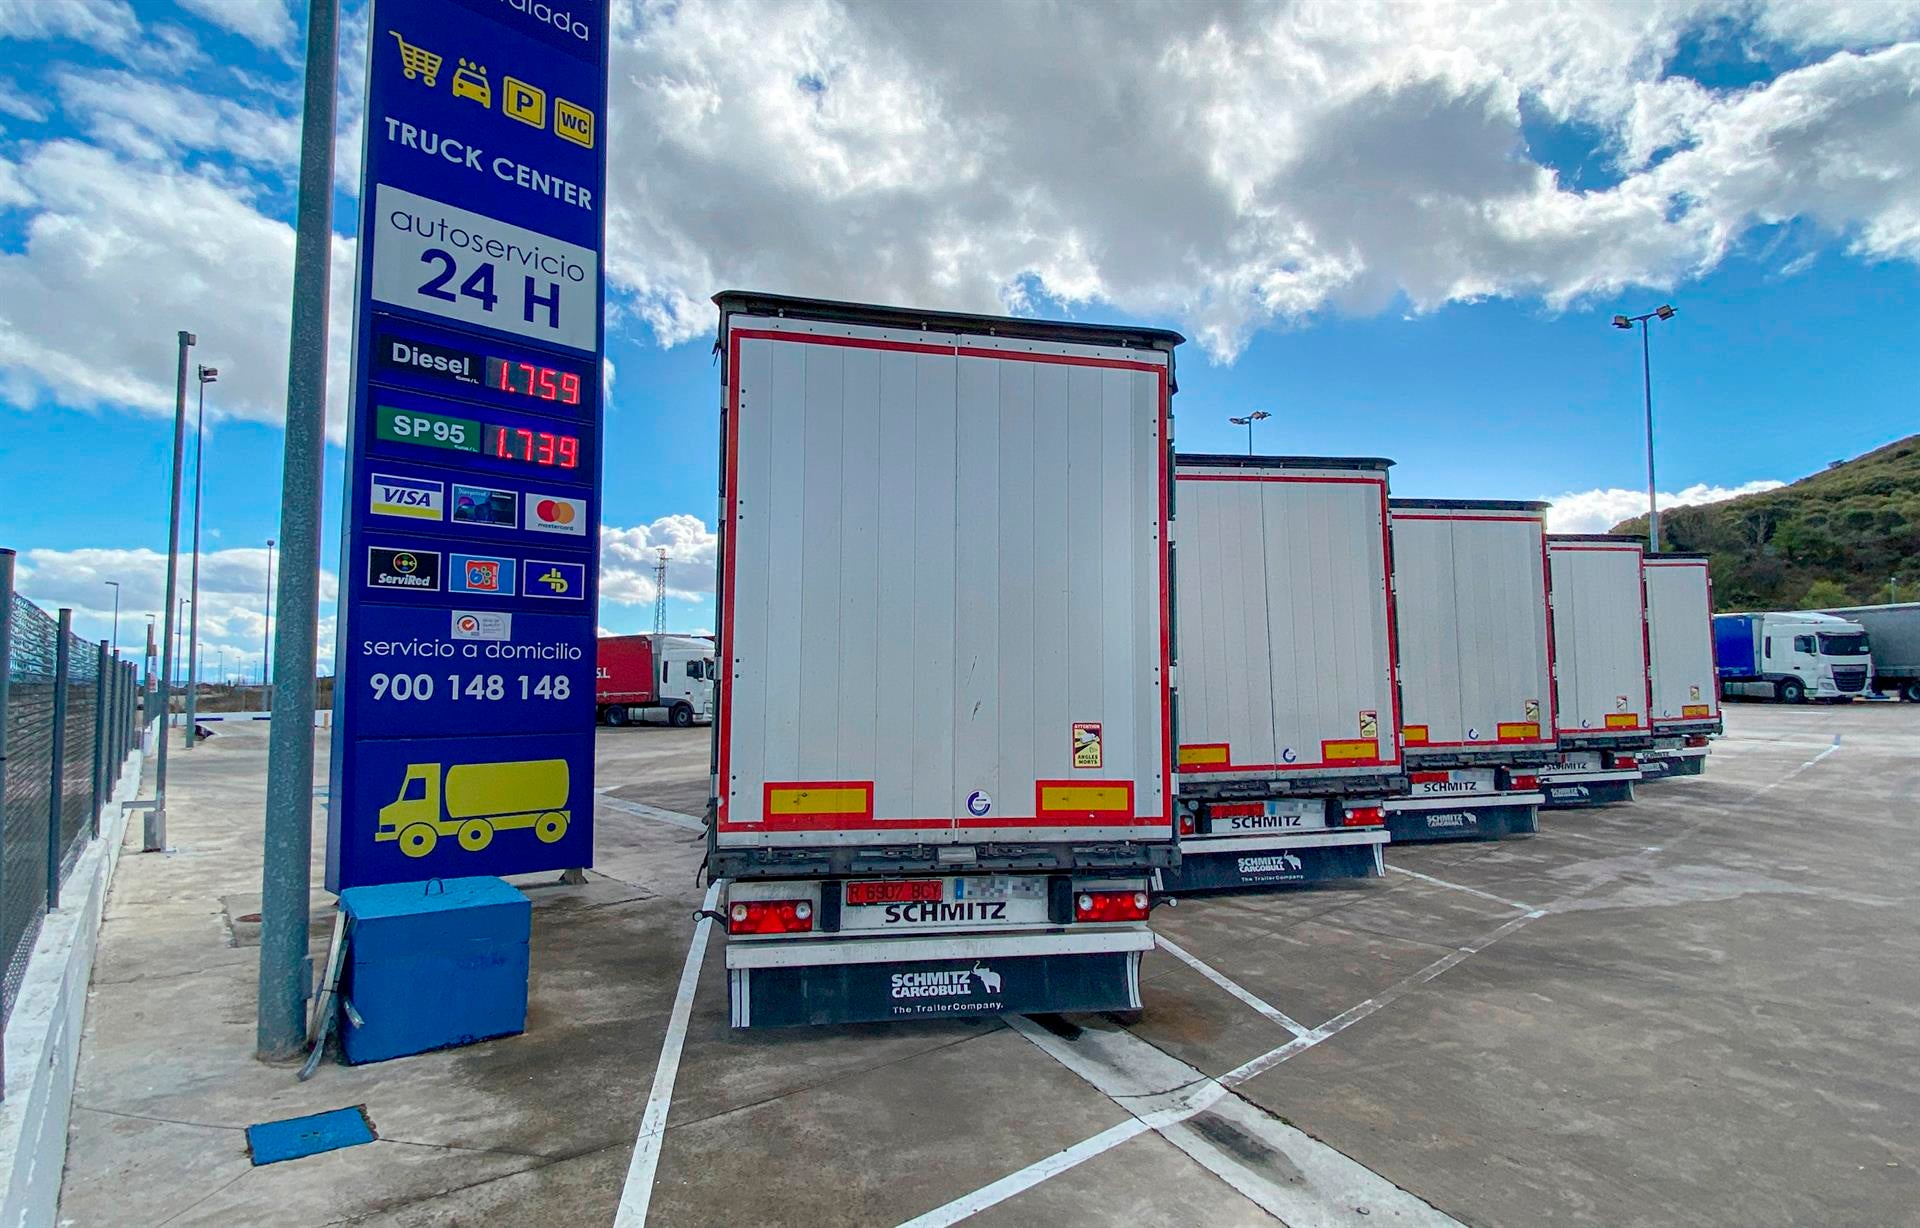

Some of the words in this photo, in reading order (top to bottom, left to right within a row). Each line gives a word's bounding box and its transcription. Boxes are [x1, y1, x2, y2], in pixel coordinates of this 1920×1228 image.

[516, 90, 533, 114] P
[562, 111, 587, 135] WC
[384, 116, 483, 172] TRUCK
[493, 156, 592, 211] CENTER
[390, 208, 585, 283] autoservicio
[417, 248, 498, 313] 24
[523, 276, 560, 329] H
[392, 342, 470, 376] Diesel
[500, 360, 580, 405] 1.759
[496, 428, 578, 469] 1.739
[383, 487, 431, 508] VISA
[378, 572, 430, 587] ServiRed
[362, 637, 455, 658] servicio
[462, 643, 478, 659] a
[485, 640, 582, 661] domicilio
[369, 672, 434, 701] 900
[447, 674, 505, 701] 148
[517, 674, 571, 701] 148
[1424, 781, 1477, 793] SCHMITZ
[1231, 815, 1301, 829] SCHMITZ
[1237, 856, 1285, 867] SCHMITZ
[849, 885, 859, 900] R
[866, 884, 903, 900] 6907
[885, 901, 1007, 923] SCHMITZ
[891, 970, 971, 988] SCHMITZ
[891, 984, 972, 999] CARGOBULL
[893, 1005, 912, 1014] The
